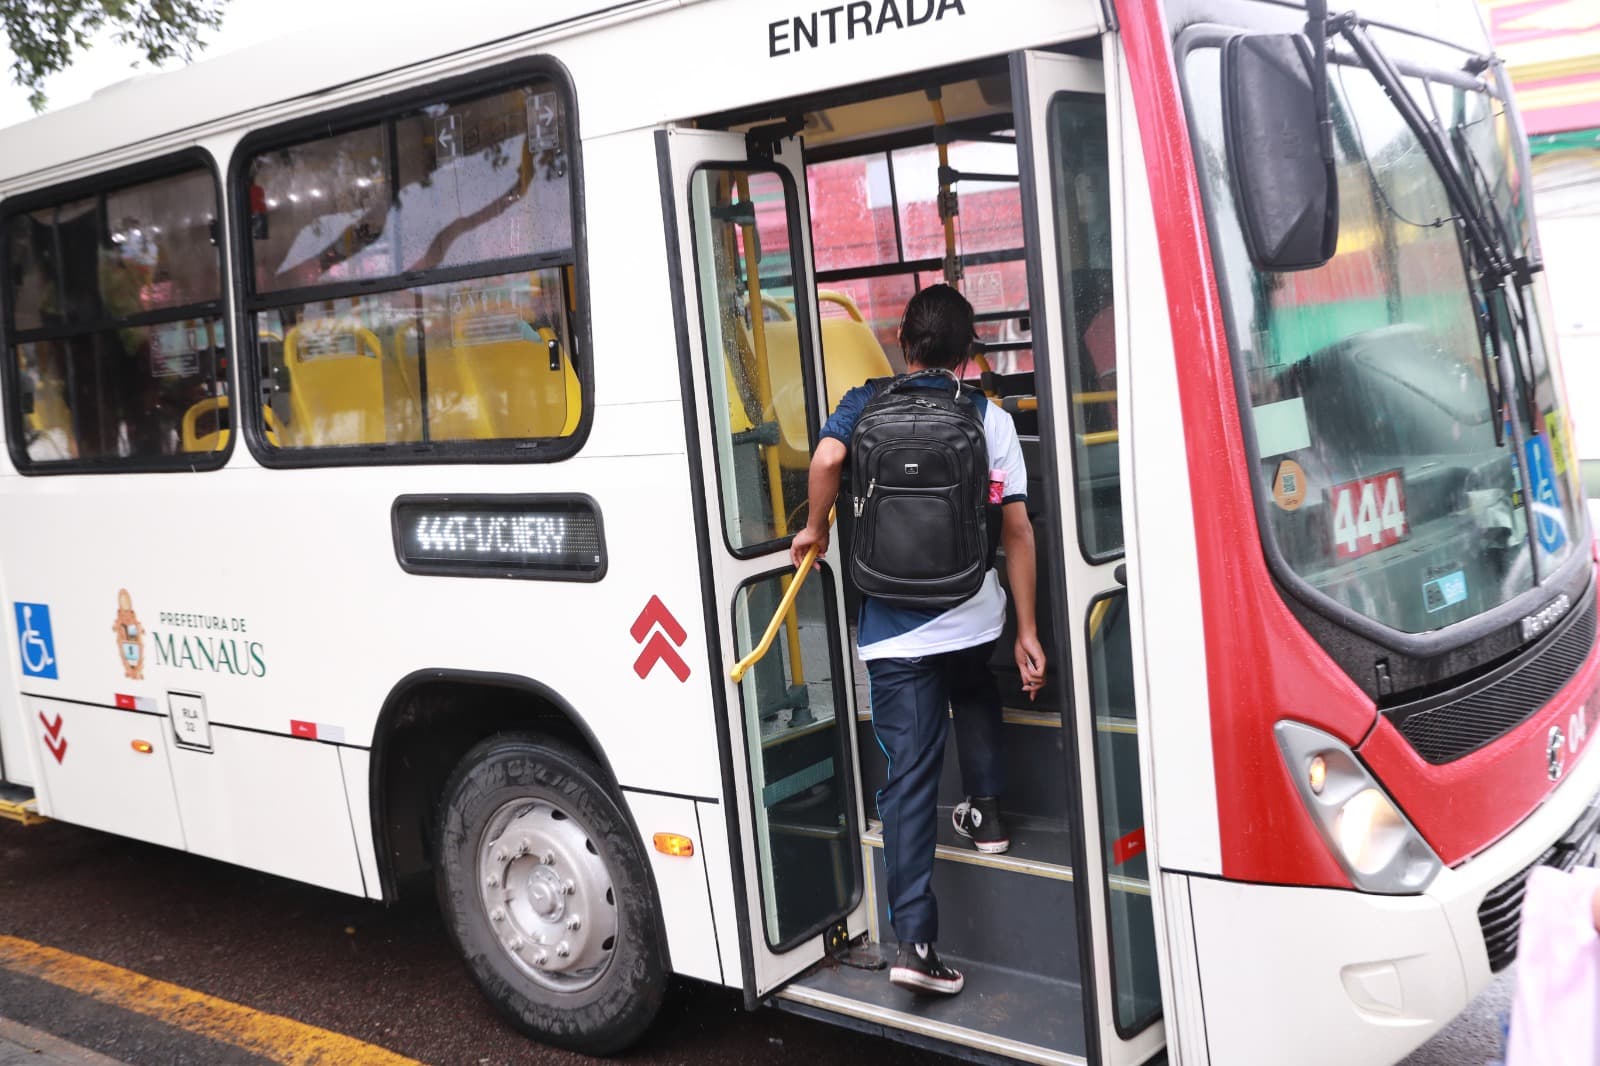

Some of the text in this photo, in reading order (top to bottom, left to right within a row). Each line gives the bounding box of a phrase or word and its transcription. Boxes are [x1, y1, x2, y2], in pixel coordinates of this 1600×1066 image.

[769, 0, 966, 58] ENTRADA
[1334, 477, 1405, 553] 444
[160, 612, 247, 633] PREFEITURA DE
[152, 631, 267, 678] MANAUS
